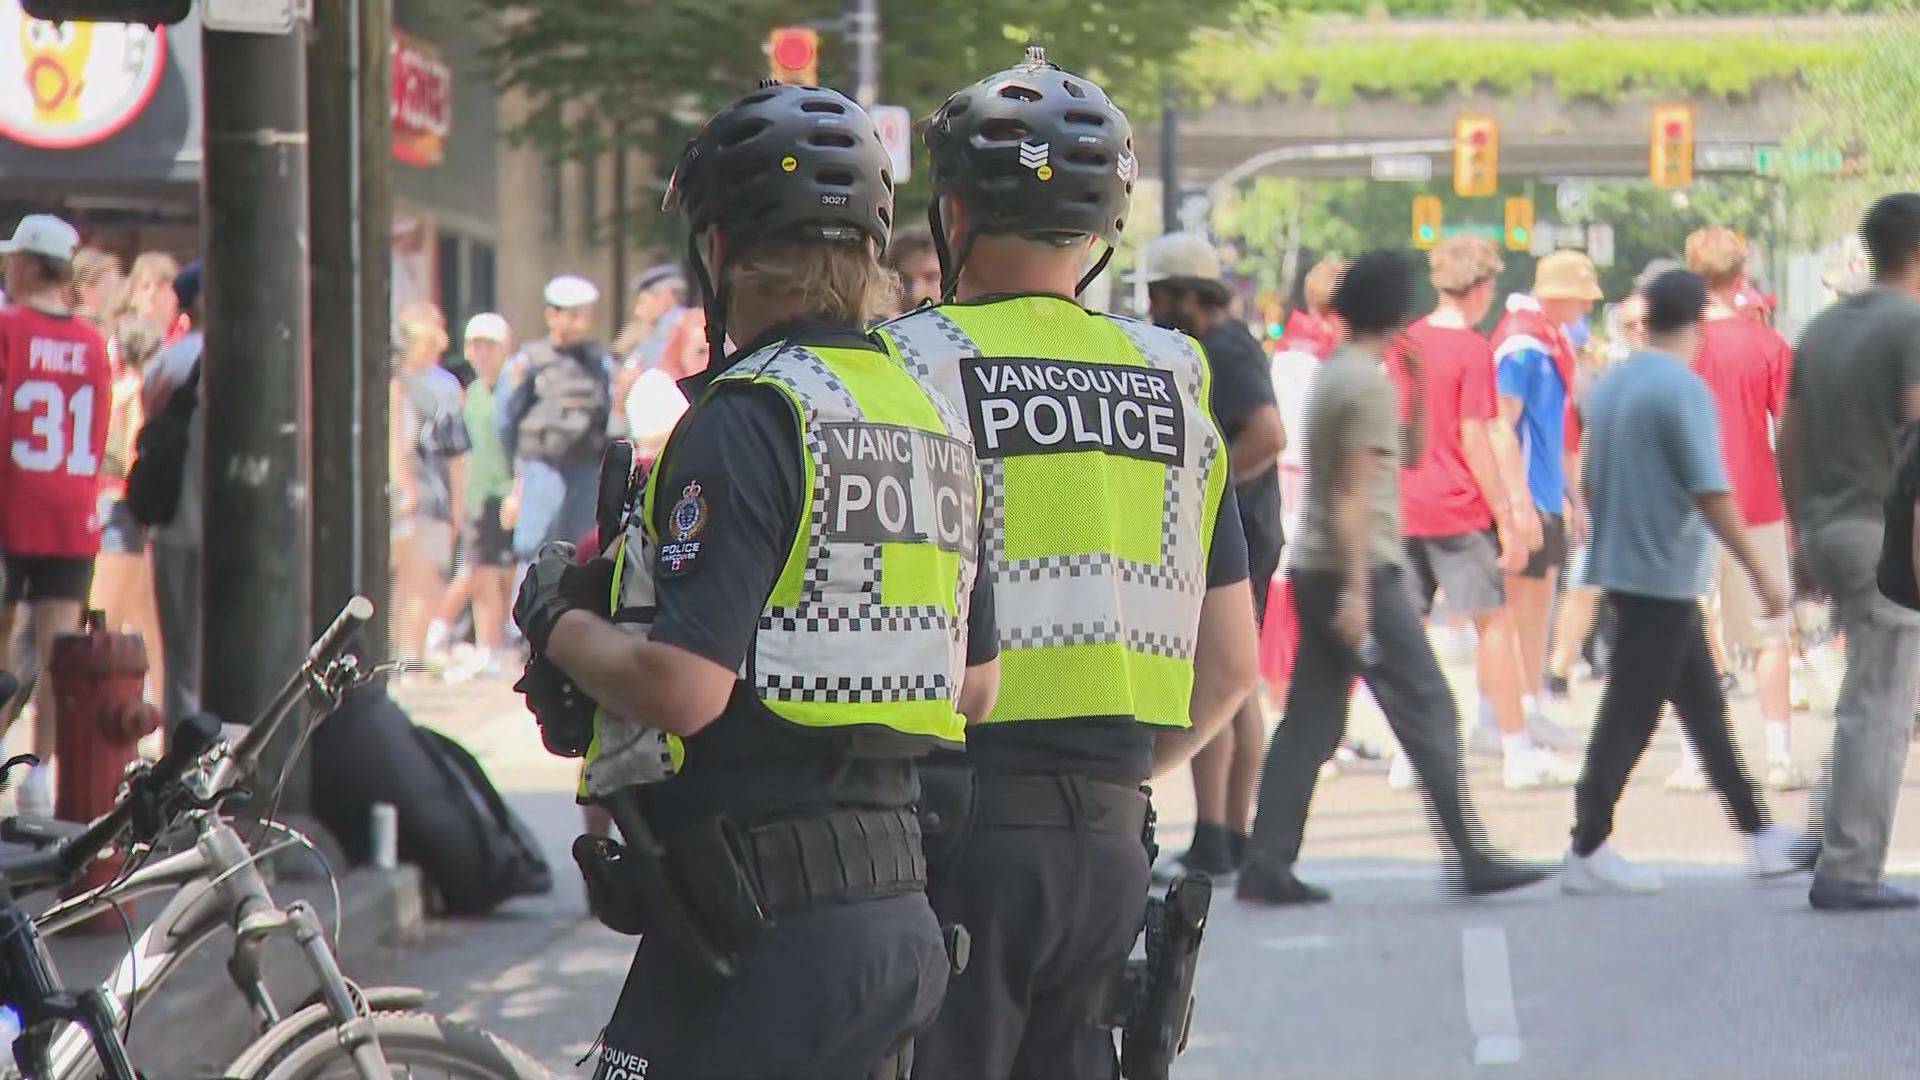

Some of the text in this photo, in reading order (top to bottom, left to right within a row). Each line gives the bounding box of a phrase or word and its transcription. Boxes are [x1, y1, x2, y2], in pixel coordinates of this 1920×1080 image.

[822, 195, 847, 205] 3027
[29, 337, 87, 375] PRICE
[974, 365, 1172, 402] VANCOUVER
[11, 380, 96, 476] 31
[980, 395, 1178, 456] POLICE
[832, 428, 970, 481] VANCUVER
[662, 543, 700, 555] POLICE
[604, 1046, 649, 1075] OUVER
